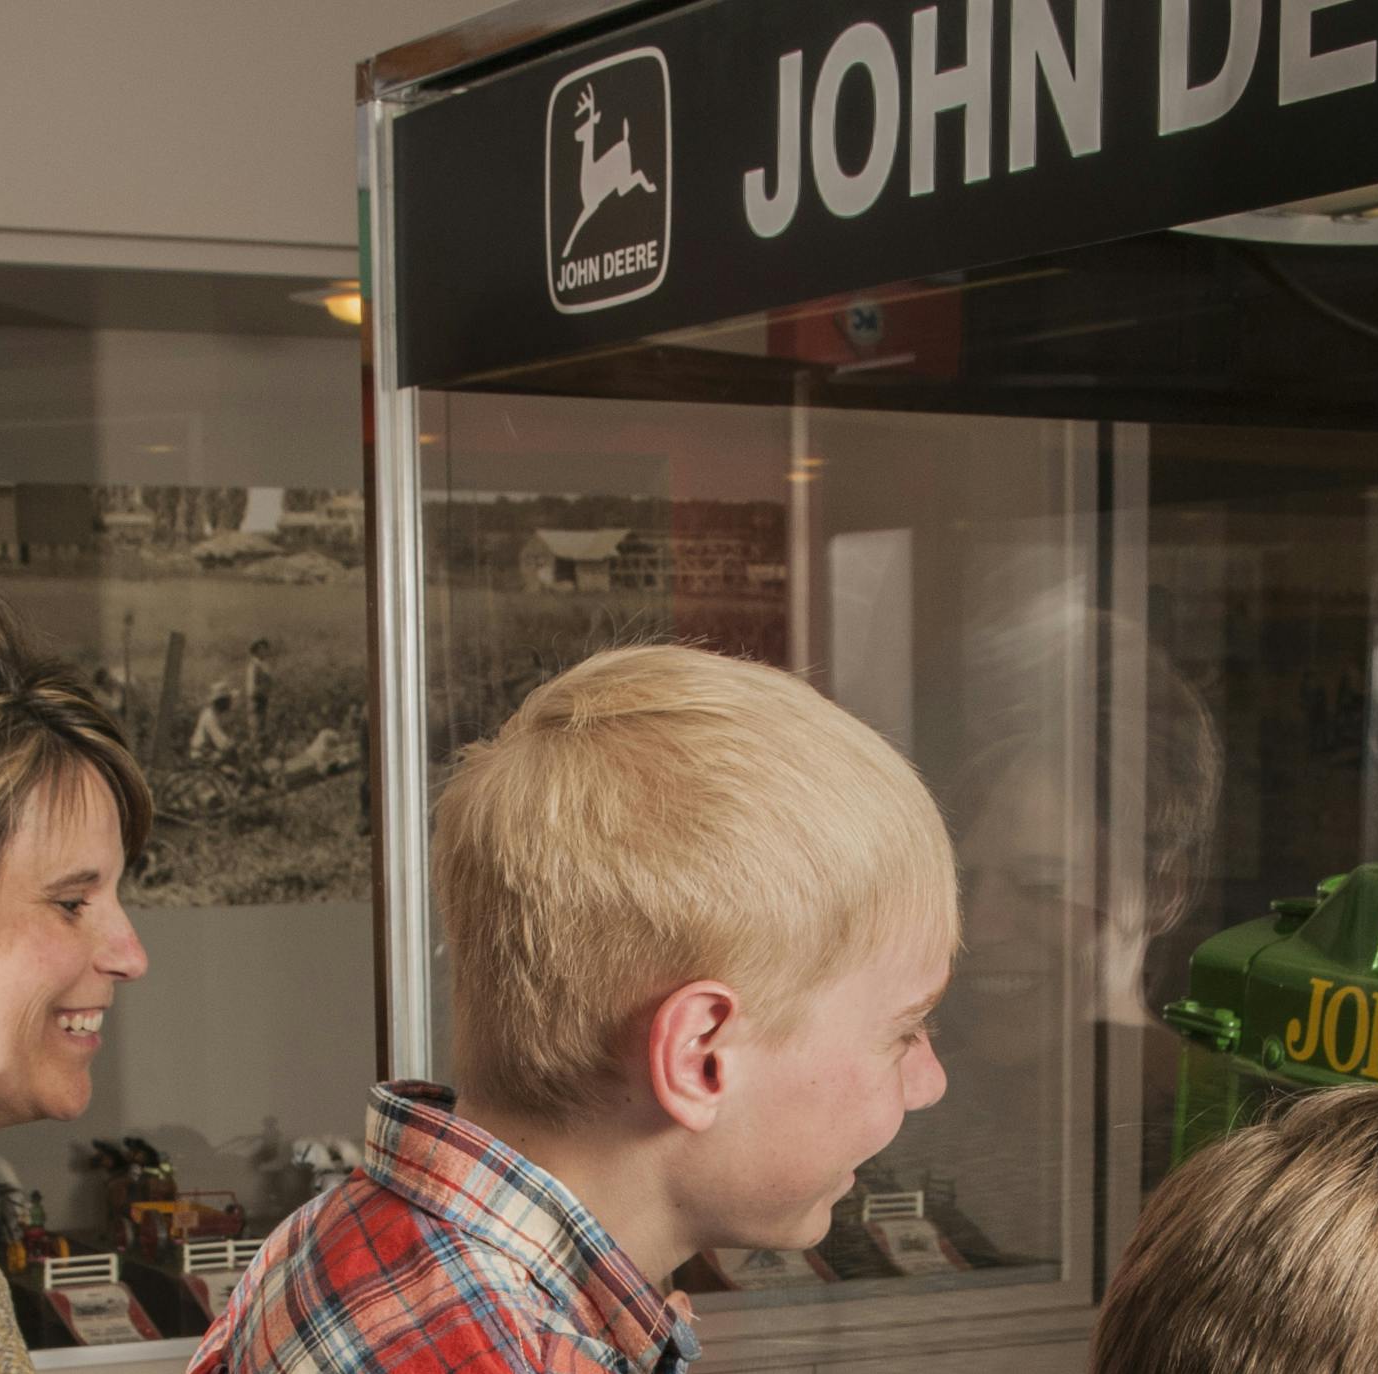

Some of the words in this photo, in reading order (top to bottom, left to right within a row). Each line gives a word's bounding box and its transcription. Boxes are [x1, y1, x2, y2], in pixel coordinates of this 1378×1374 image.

[743, 0, 1103, 238] JOHN
[557, 256, 600, 292] JOHN
[603, 240, 658, 281] DEERE
